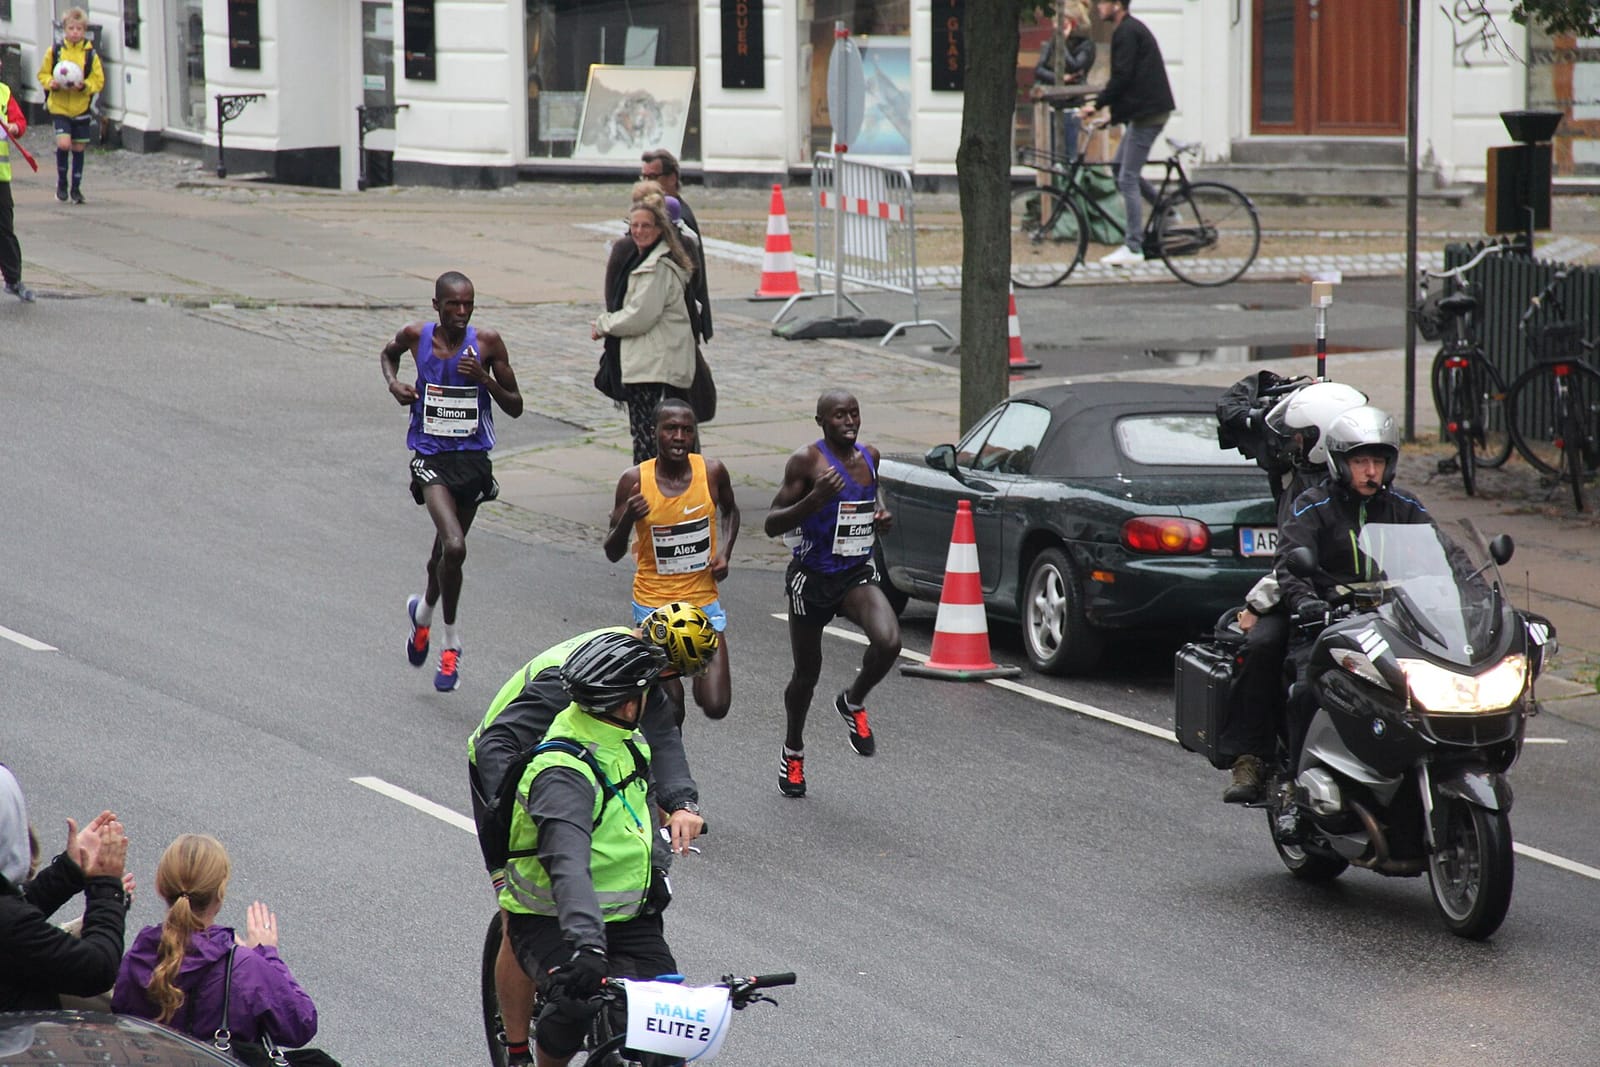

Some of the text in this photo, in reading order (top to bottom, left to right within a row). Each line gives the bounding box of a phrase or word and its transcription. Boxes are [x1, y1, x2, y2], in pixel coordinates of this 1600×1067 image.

[736, 0, 748, 56] DUER
[946, 16, 959, 71] GLAS
[436, 407, 466, 419] Simon
[849, 525, 872, 536] Edwin
[673, 545, 697, 556] Alex
[655, 1002, 706, 1023] MALE
[646, 1017, 711, 1041] ELITE 2
